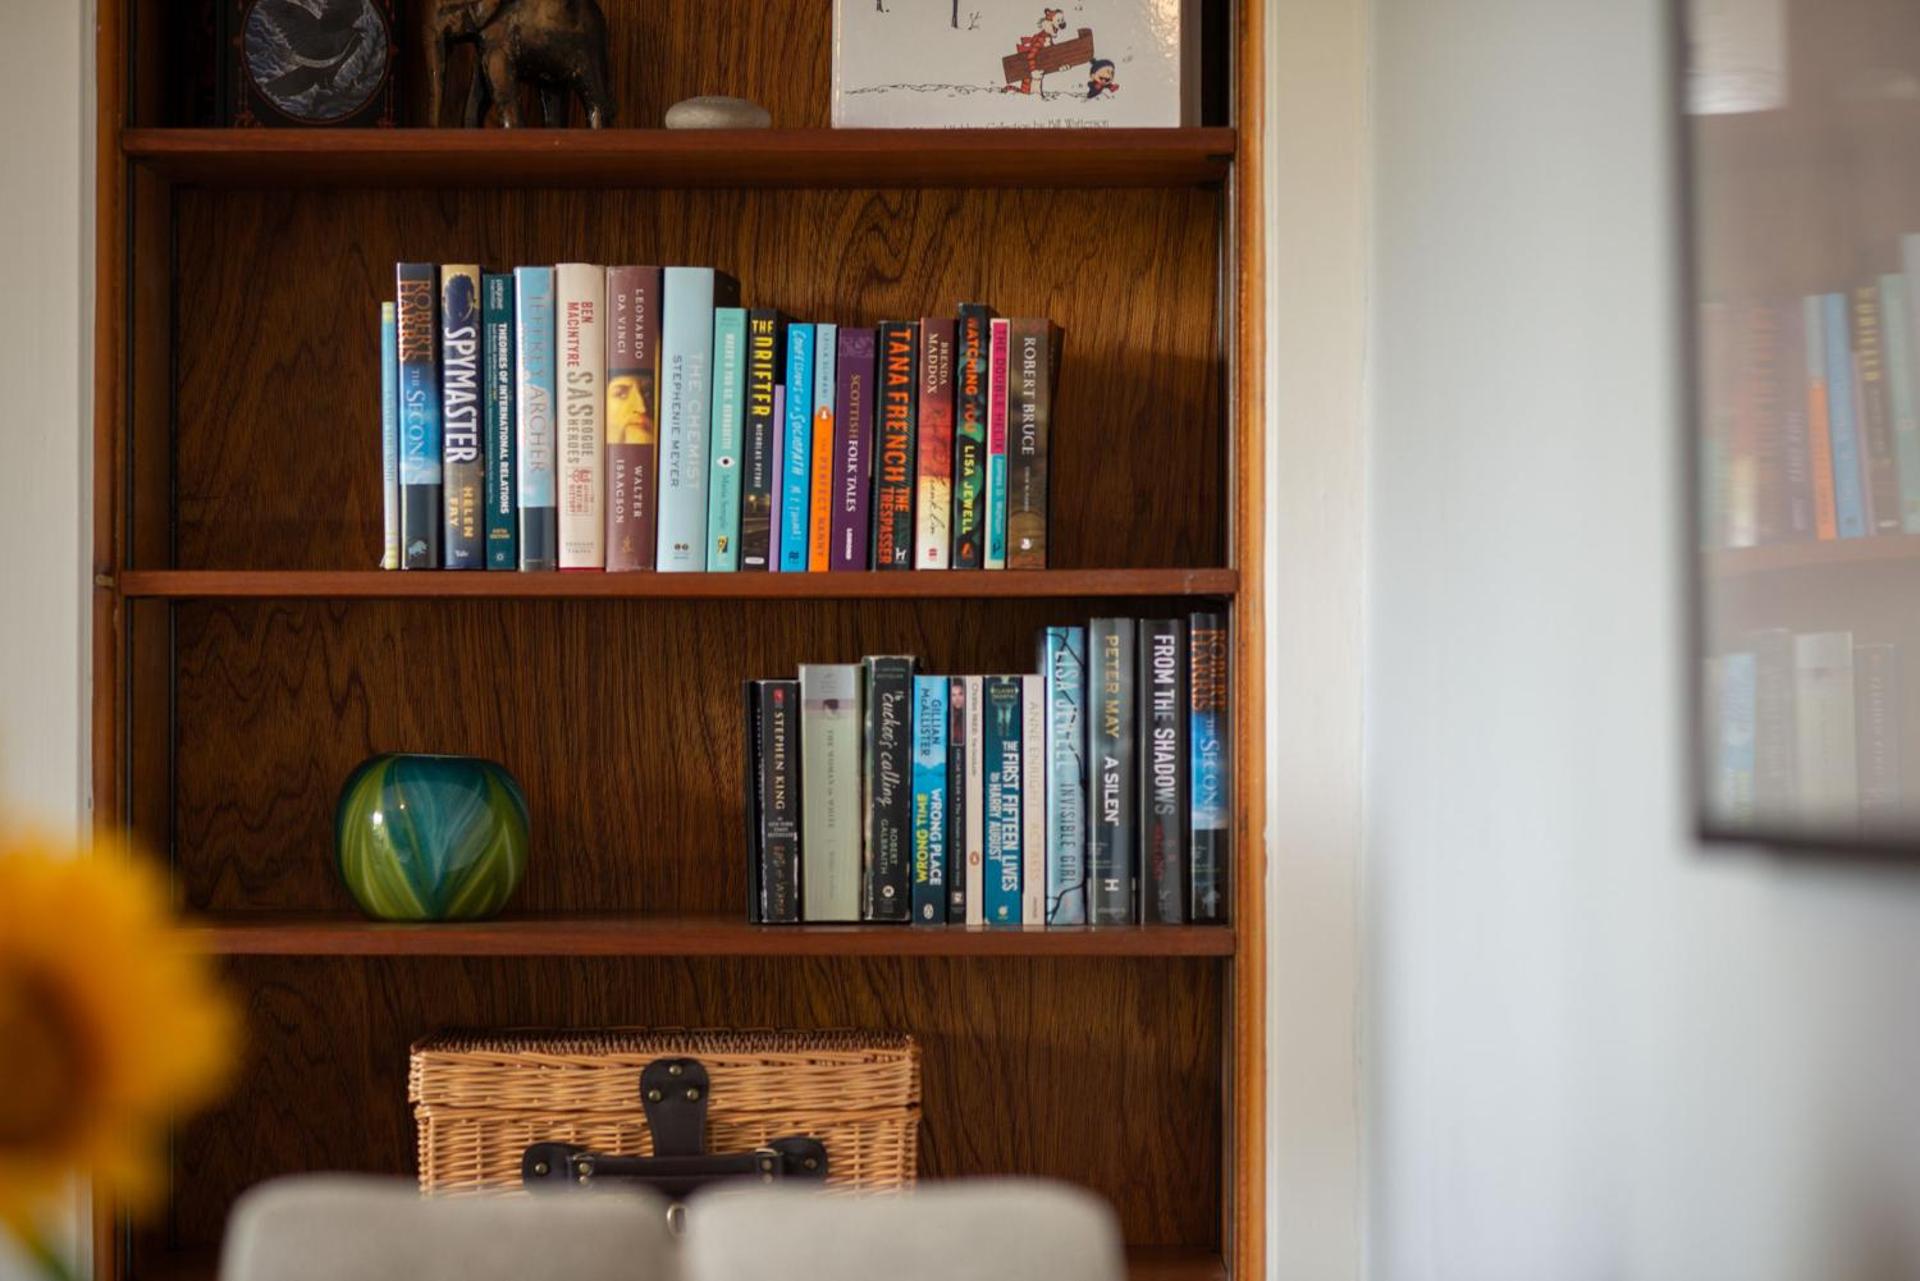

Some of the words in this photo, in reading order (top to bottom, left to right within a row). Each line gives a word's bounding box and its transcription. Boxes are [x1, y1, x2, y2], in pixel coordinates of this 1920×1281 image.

[398, 280, 414, 362] HARRIS
[414, 280, 432, 361] ROBERT
[580, 301, 594, 324] BEN
[616, 293, 627, 312] DA
[634, 288, 645, 361] LEONARDO
[752, 320, 774, 334] THE
[498, 322, 509, 369] THEORIES
[528, 295, 546, 378] JEFFREY
[566, 302, 580, 370] MACINTYRE
[616, 315, 627, 355] VINCI
[888, 328, 912, 386] TANA
[964, 318, 980, 397] WATCHING
[411, 369, 420, 387] THE
[499, 370, 509, 383] OF
[688, 350, 704, 393] THE
[752, 336, 774, 416] DRIFTER
[926, 333, 940, 396] MADDOX
[938, 341, 950, 386] BRENDA
[1023, 337, 1037, 400] ROBERT
[444, 326, 477, 465] SPYMASTER
[566, 371, 594, 417] SAS
[670, 354, 683, 436] STEPHENIE
[849, 373, 862, 439] SCOTTISH
[963, 402, 978, 434] YOU
[499, 384, 509, 460] INTERNATIONAL
[528, 386, 547, 473] ARCHER
[567, 418, 581, 464] HEROES
[581, 418, 595, 457] ROGUE
[686, 398, 703, 491] CHEMIST
[883, 391, 910, 482] FRENCH
[1021, 403, 1036, 457] BRUCE
[669, 438, 682, 491] MEYER
[847, 439, 859, 473] FOLK
[964, 445, 976, 477] LISA
[462, 486, 474, 539] HELEN
[499, 461, 509, 514] RELATIONS
[614, 458, 626, 526] ISAACSON
[632, 464, 644, 520] WALTER
[846, 475, 857, 513] TALES
[895, 487, 910, 513] THE
[962, 481, 974, 535] JEWELL
[879, 487, 895, 565] TRESPASSER
[1055, 649, 1079, 691] LISA
[1104, 634, 1120, 694] PETER
[1153, 634, 1176, 684] FROM
[920, 687, 931, 757] McALLISTER
[931, 699, 942, 746] GILLIAN
[1029, 702, 1041, 742] ANNE
[1104, 699, 1120, 739] MAY
[1153, 689, 1175, 722] THE
[775, 711, 785, 771] STEPHEN
[1055, 697, 1078, 770] JEWELL
[876, 751, 901, 807] calling
[1002, 752, 1020, 790] FIRST
[1104, 756, 1119, 769] A
[1154, 727, 1176, 815] SHADOWS
[774, 775, 786, 811] KING
[929, 787, 943, 842] WRONG
[988, 783, 1002, 819] HARRY
[1060, 783, 1077, 848] INVISIBLE
[1104, 771, 1120, 827] SILEN
[880, 818, 890, 876] GALBRAITH
[889, 827, 899, 866] ROBERT
[988, 820, 1002, 863] AUGUST
[1002, 794, 1019, 851] FIFTEEN
[929, 843, 943, 886] PLACE
[1001, 854, 1018, 893] LIVES
[1060, 855, 1076, 884] GIRL
